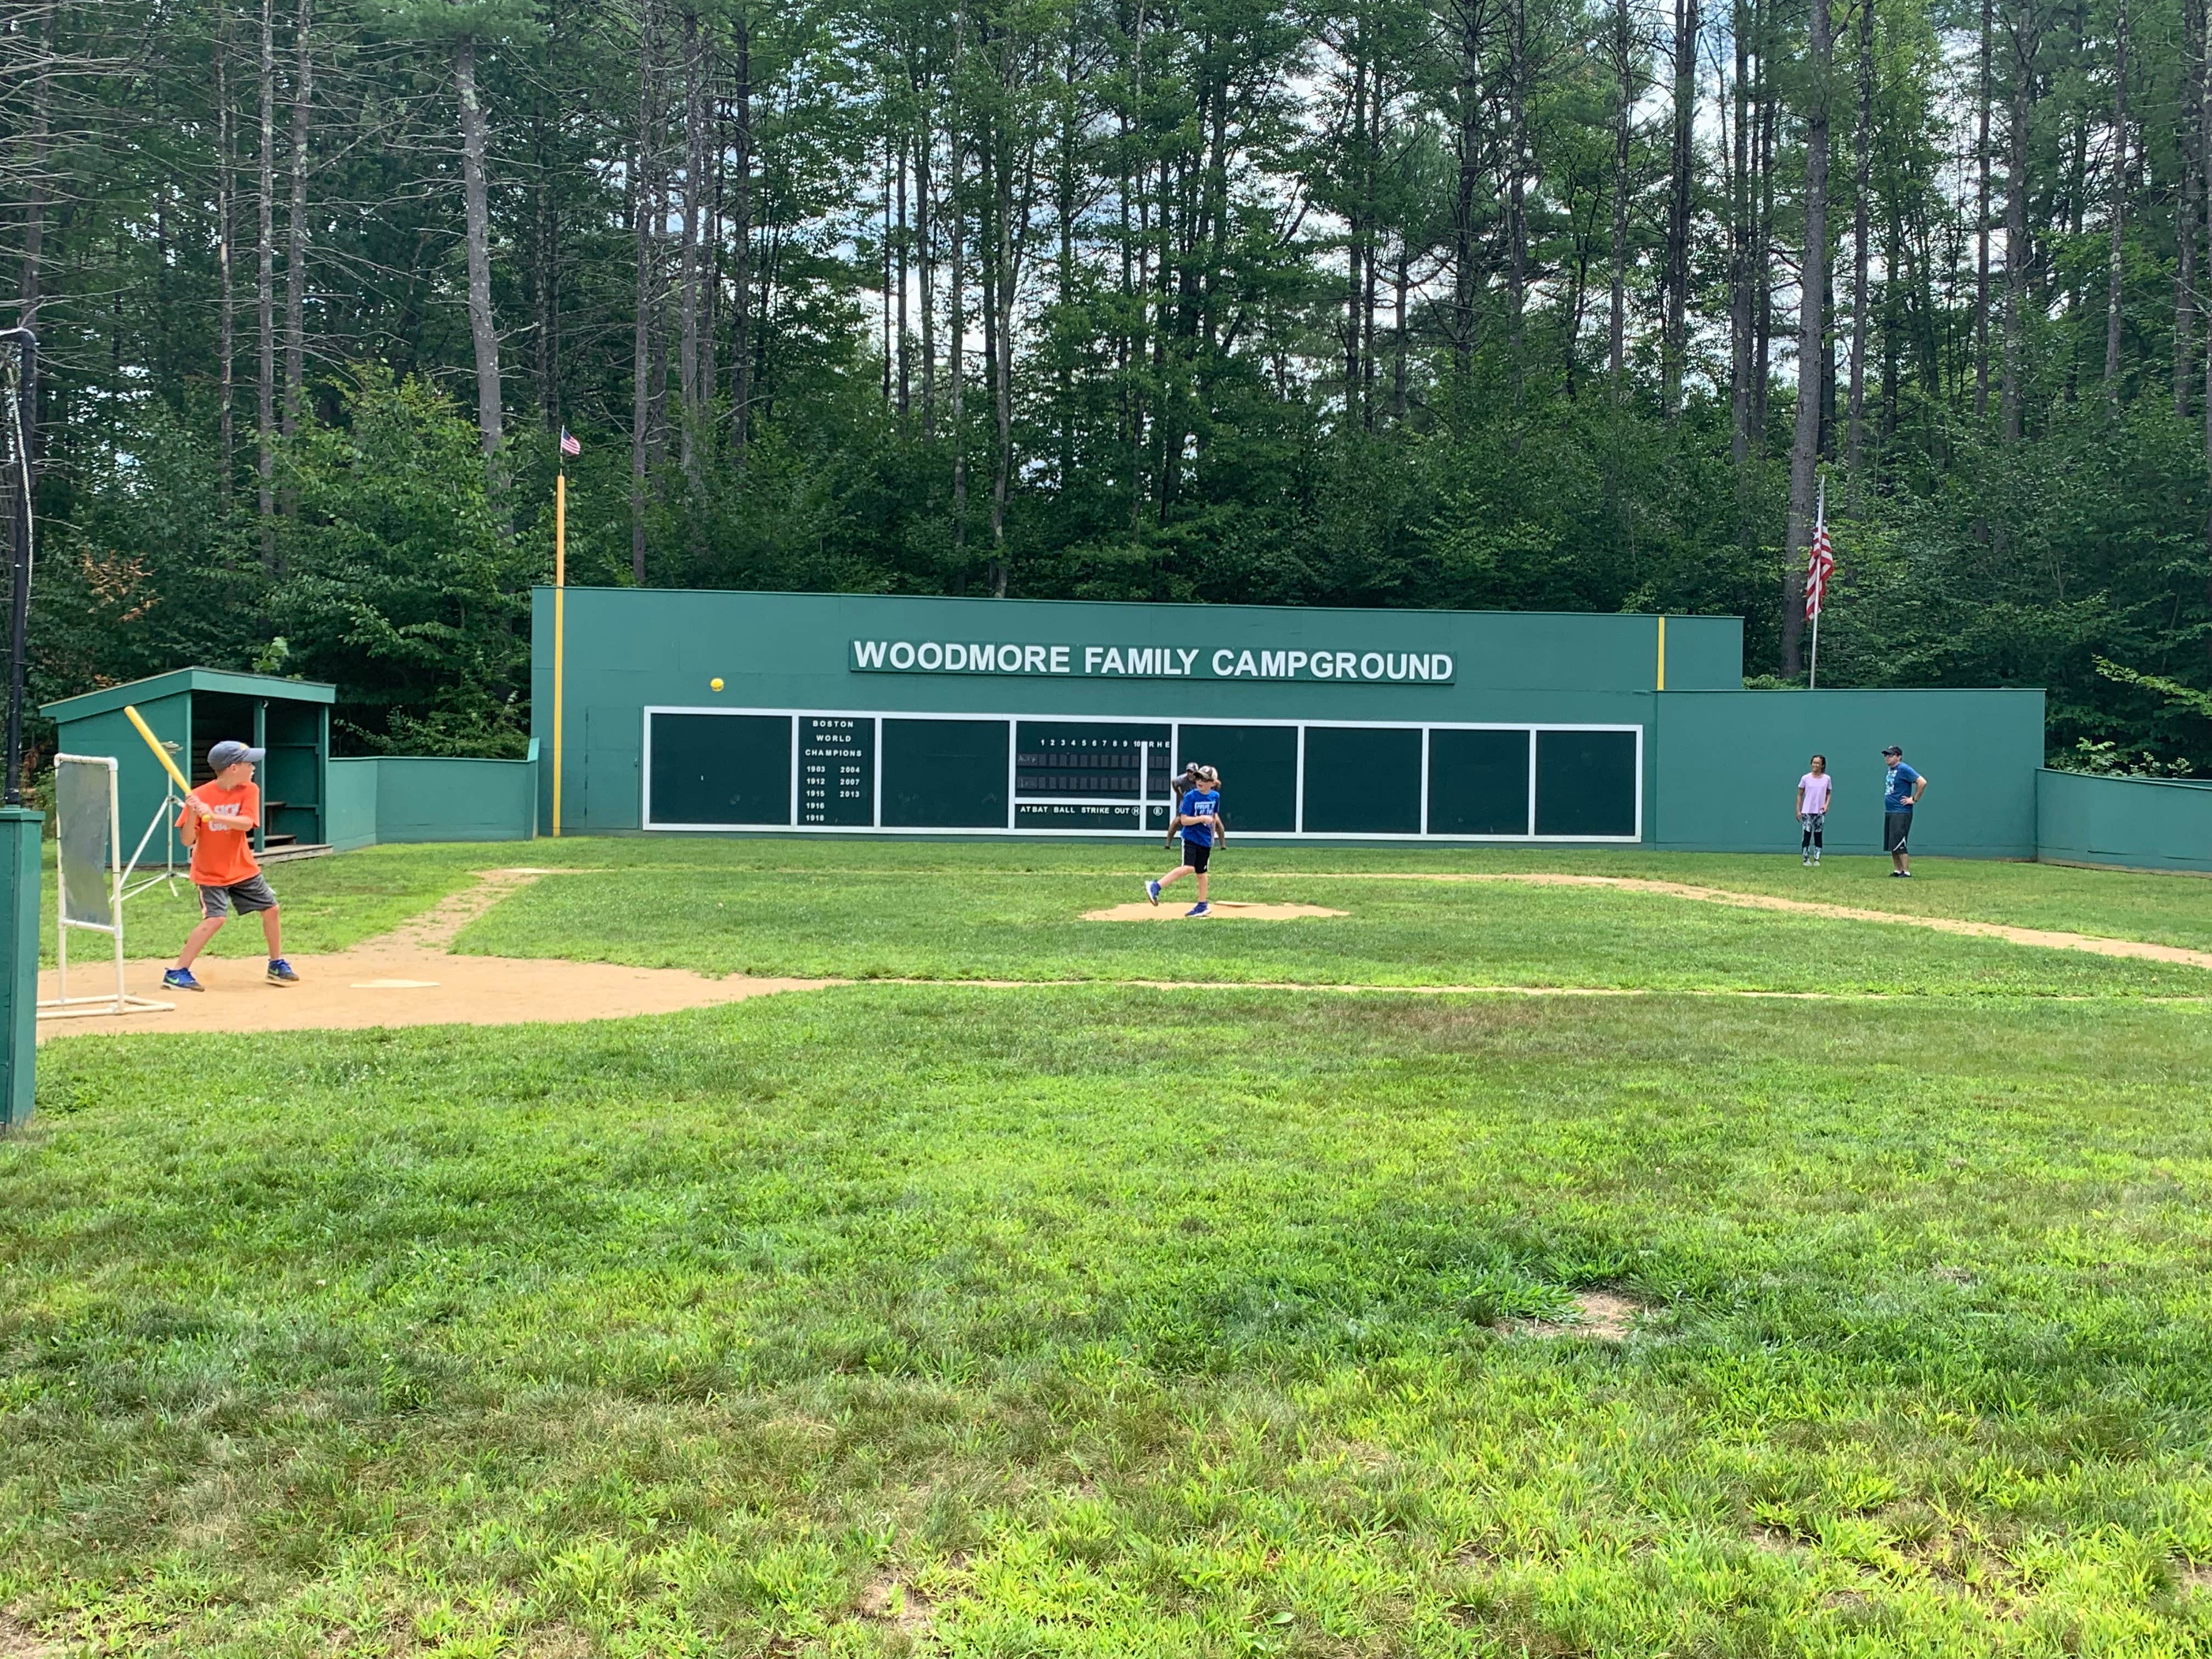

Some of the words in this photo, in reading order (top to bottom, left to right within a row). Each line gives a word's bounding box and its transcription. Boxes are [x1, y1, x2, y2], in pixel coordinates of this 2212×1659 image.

[854, 641, 1070, 673] WOODMORE
[1085, 647, 1199, 675] FAMILY
[1212, 650, 1452, 680] CAMPGROUND
[805, 749, 862, 757] CHAMPIONS
